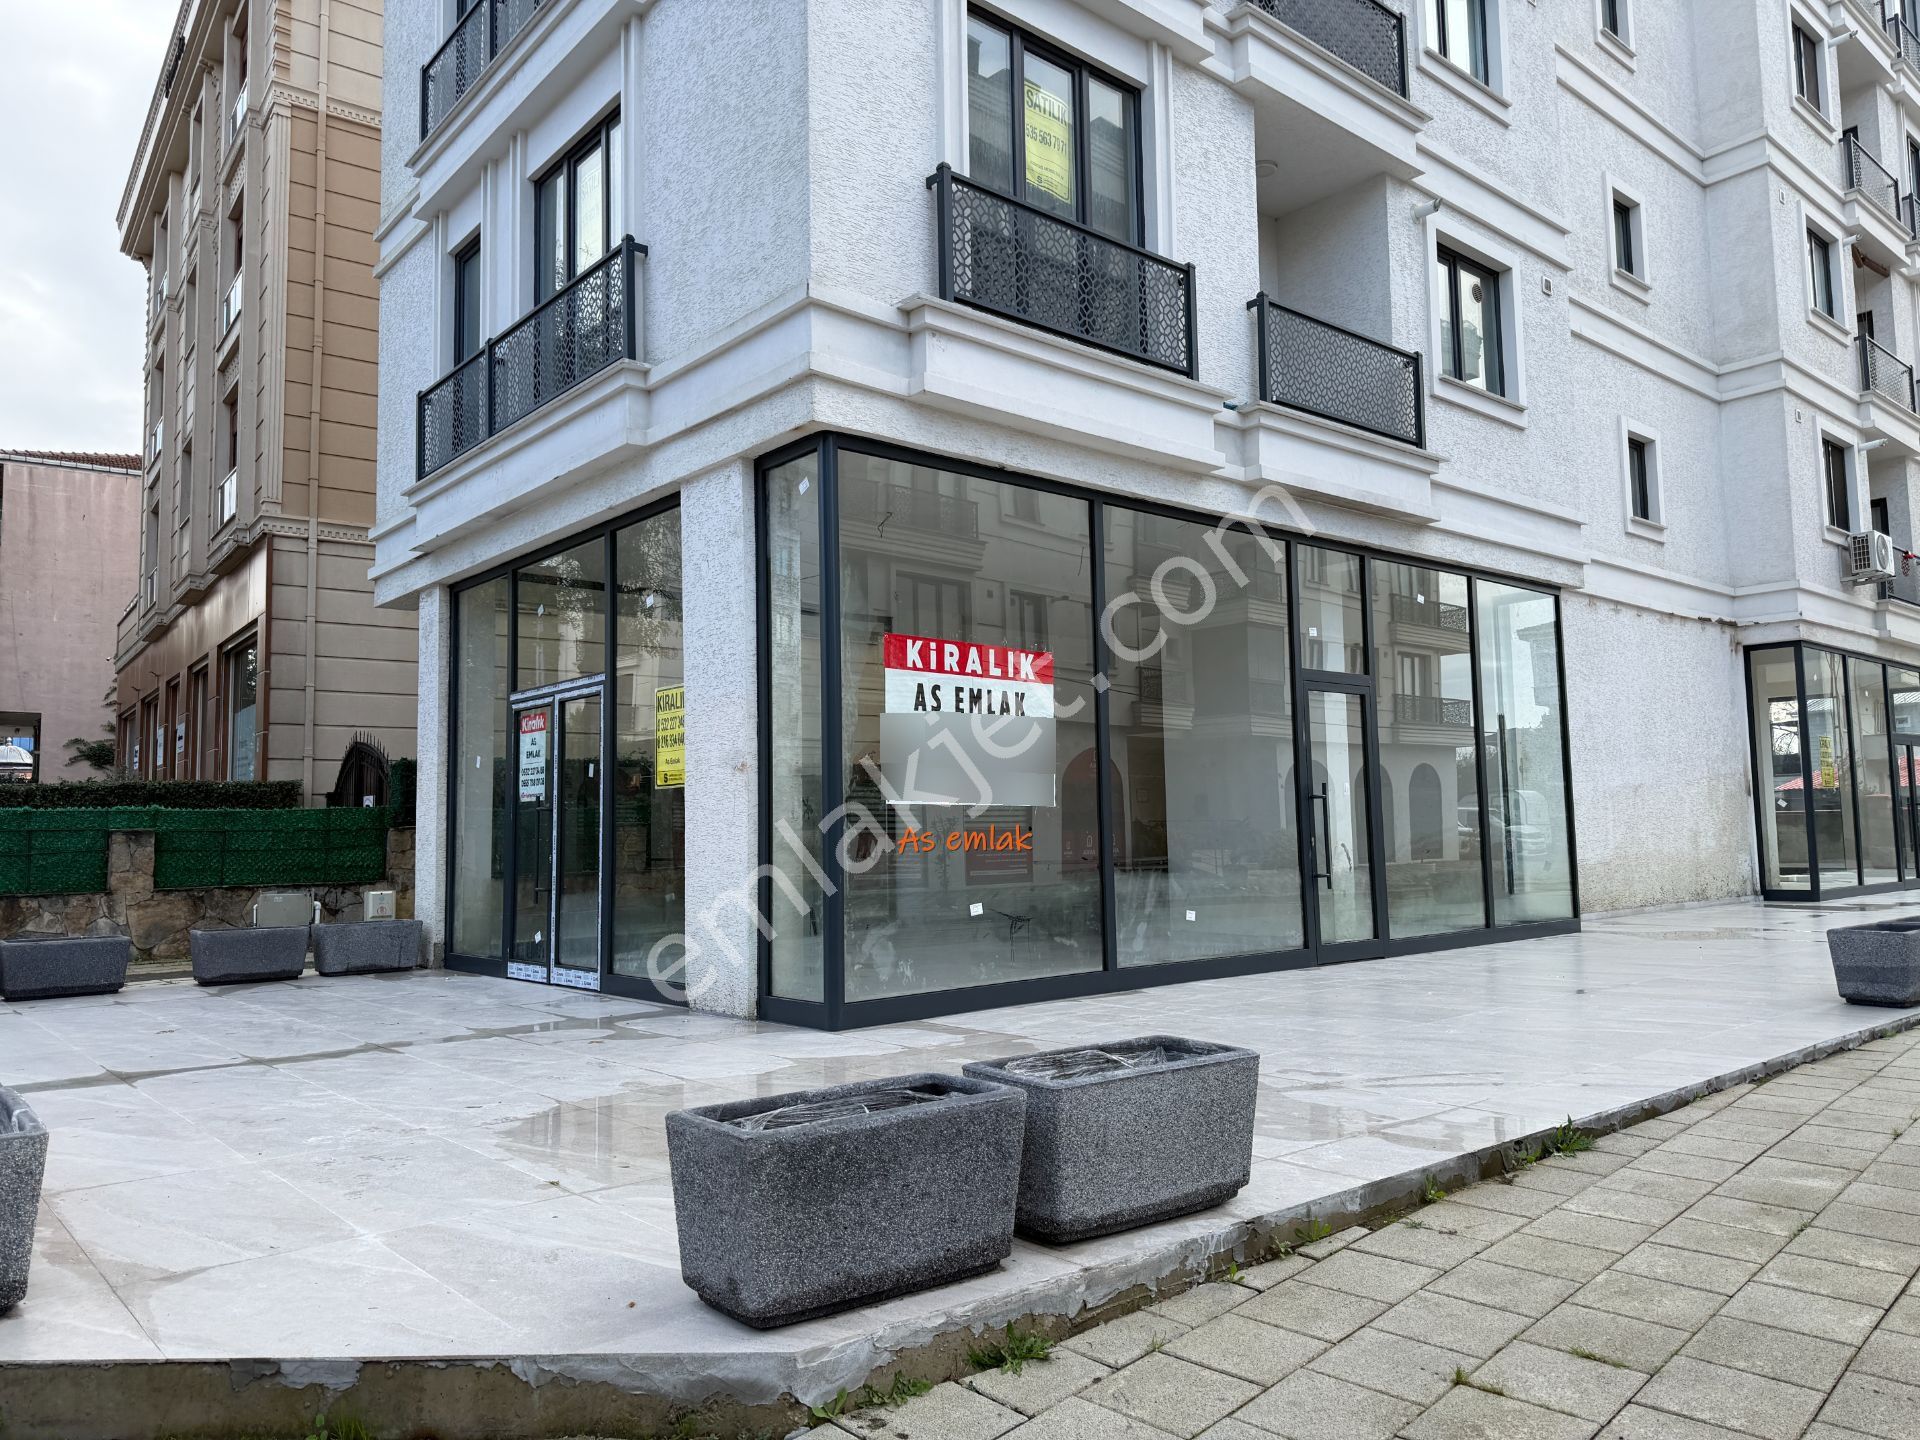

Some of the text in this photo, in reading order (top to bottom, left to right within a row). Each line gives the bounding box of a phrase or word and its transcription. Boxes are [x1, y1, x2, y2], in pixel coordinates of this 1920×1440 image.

[1026, 89, 1067, 127] SATILIK
[914, 683, 1026, 717] AS EMLAK
